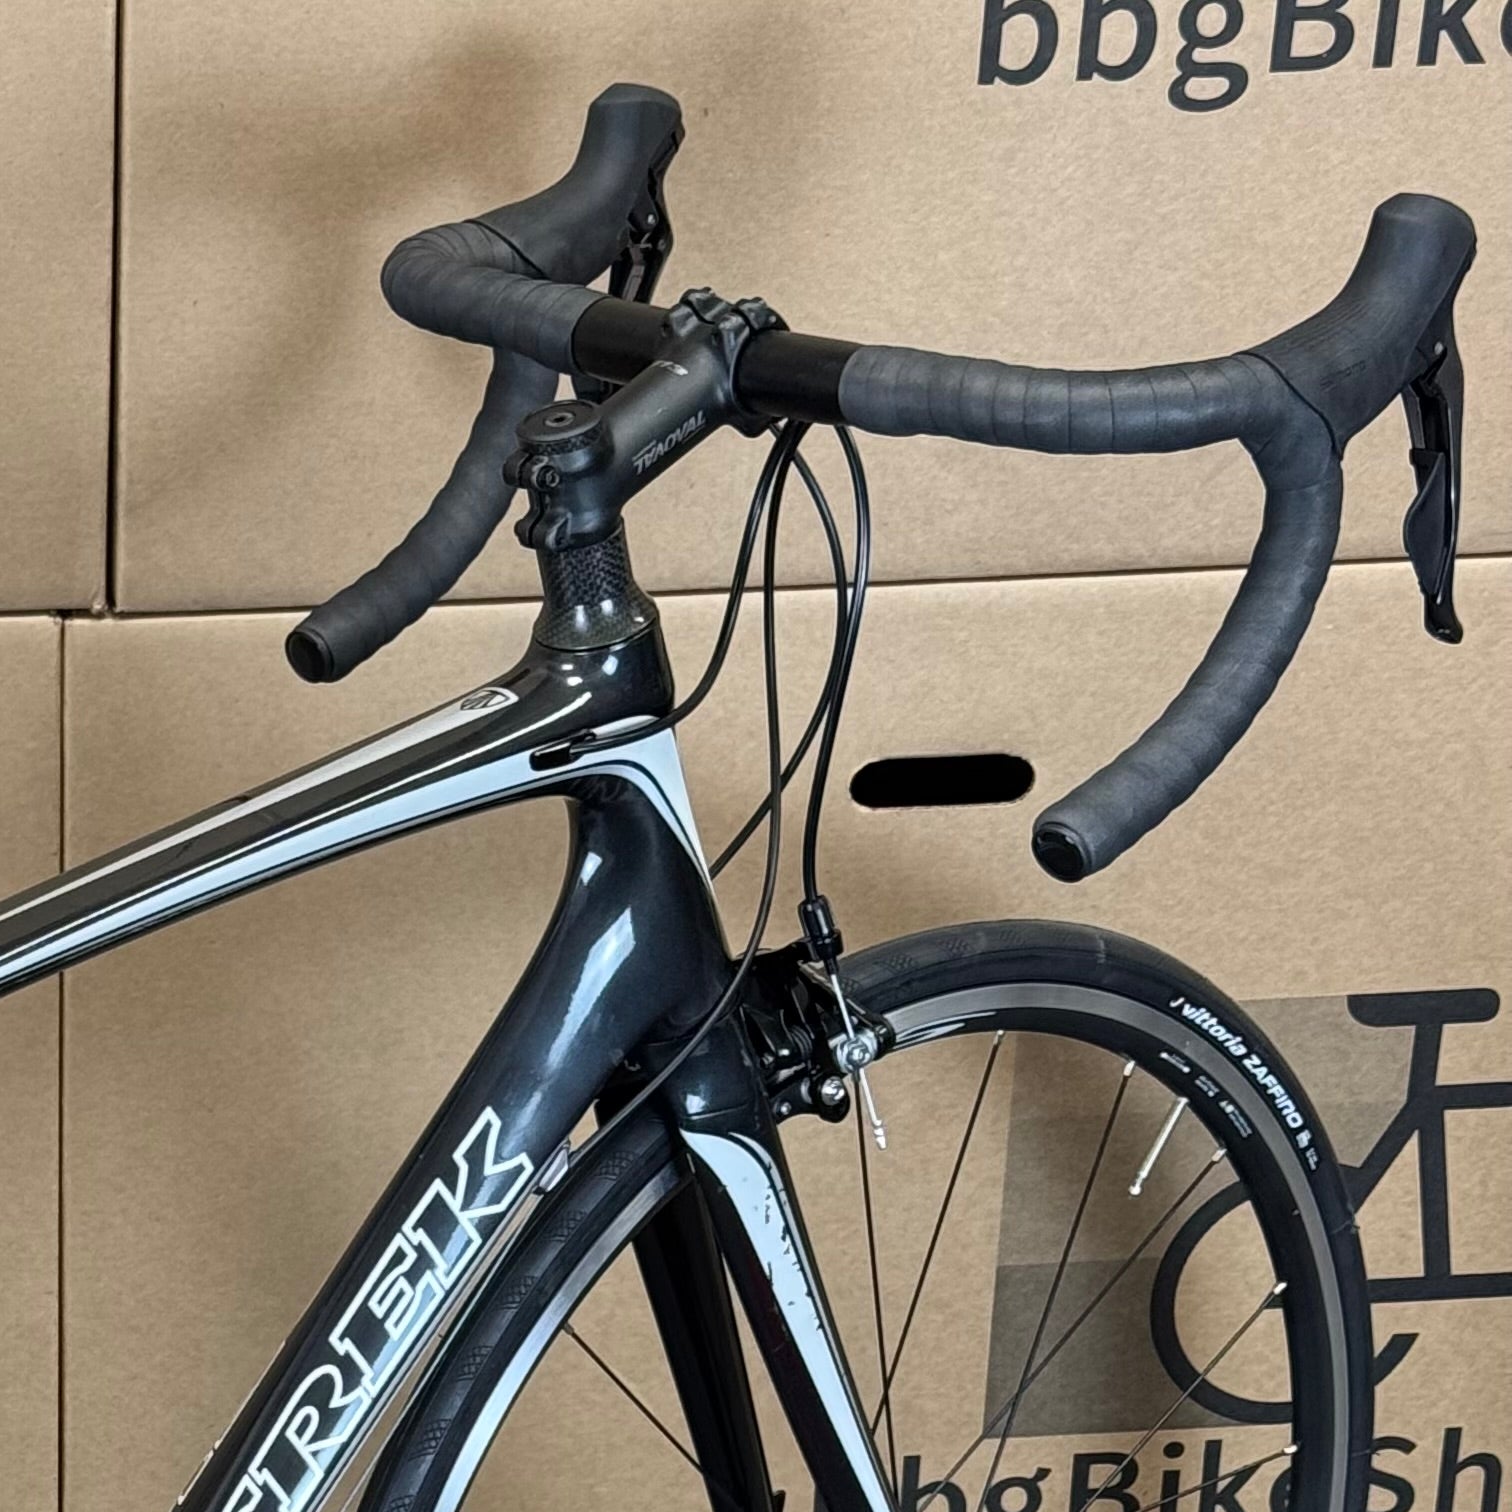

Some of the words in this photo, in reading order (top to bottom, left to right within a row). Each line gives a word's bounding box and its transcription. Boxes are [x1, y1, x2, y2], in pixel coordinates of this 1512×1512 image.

[977, 0, 1512, 112] bbgBik
[1178, 1001, 1248, 1056] vittoria
[1242, 1054, 1304, 1129] ZAFFIRO
